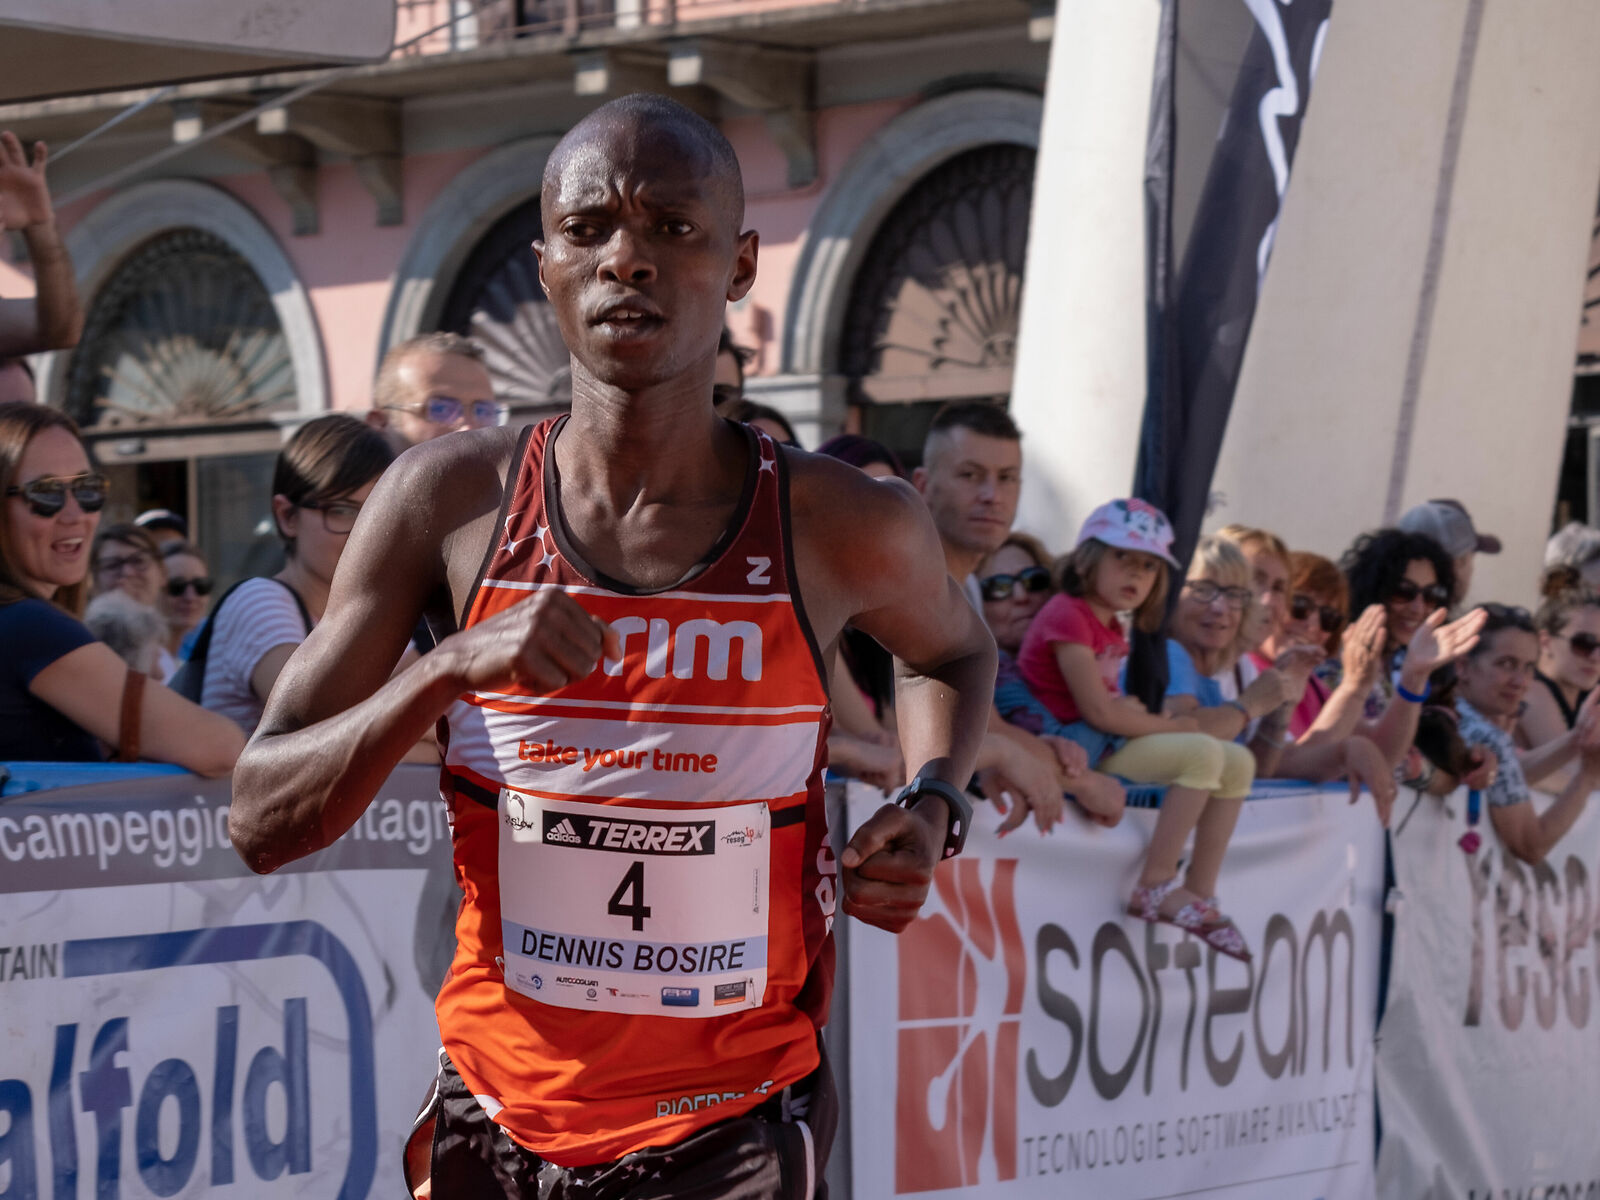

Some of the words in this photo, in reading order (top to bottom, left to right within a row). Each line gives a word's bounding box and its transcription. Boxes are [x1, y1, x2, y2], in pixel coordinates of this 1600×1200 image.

[594, 615, 763, 682] rim
[518, 739, 578, 765] take
[583, 747, 648, 772] your
[653, 748, 718, 773] time
[546, 832, 582, 844] adidas
[588, 820, 711, 852] TERREX
[608, 861, 651, 931] 4
[0, 943, 58, 982] TAIN
[521, 929, 625, 969] DENNIS
[633, 941, 746, 974] BOSIRE
[1453, 848, 1600, 1032] rese
[1025, 908, 1355, 1108] softeam
[1023, 1122, 1166, 1177] TECNOLOGIE
[1175, 1107, 1271, 1157] SOFTWARE
